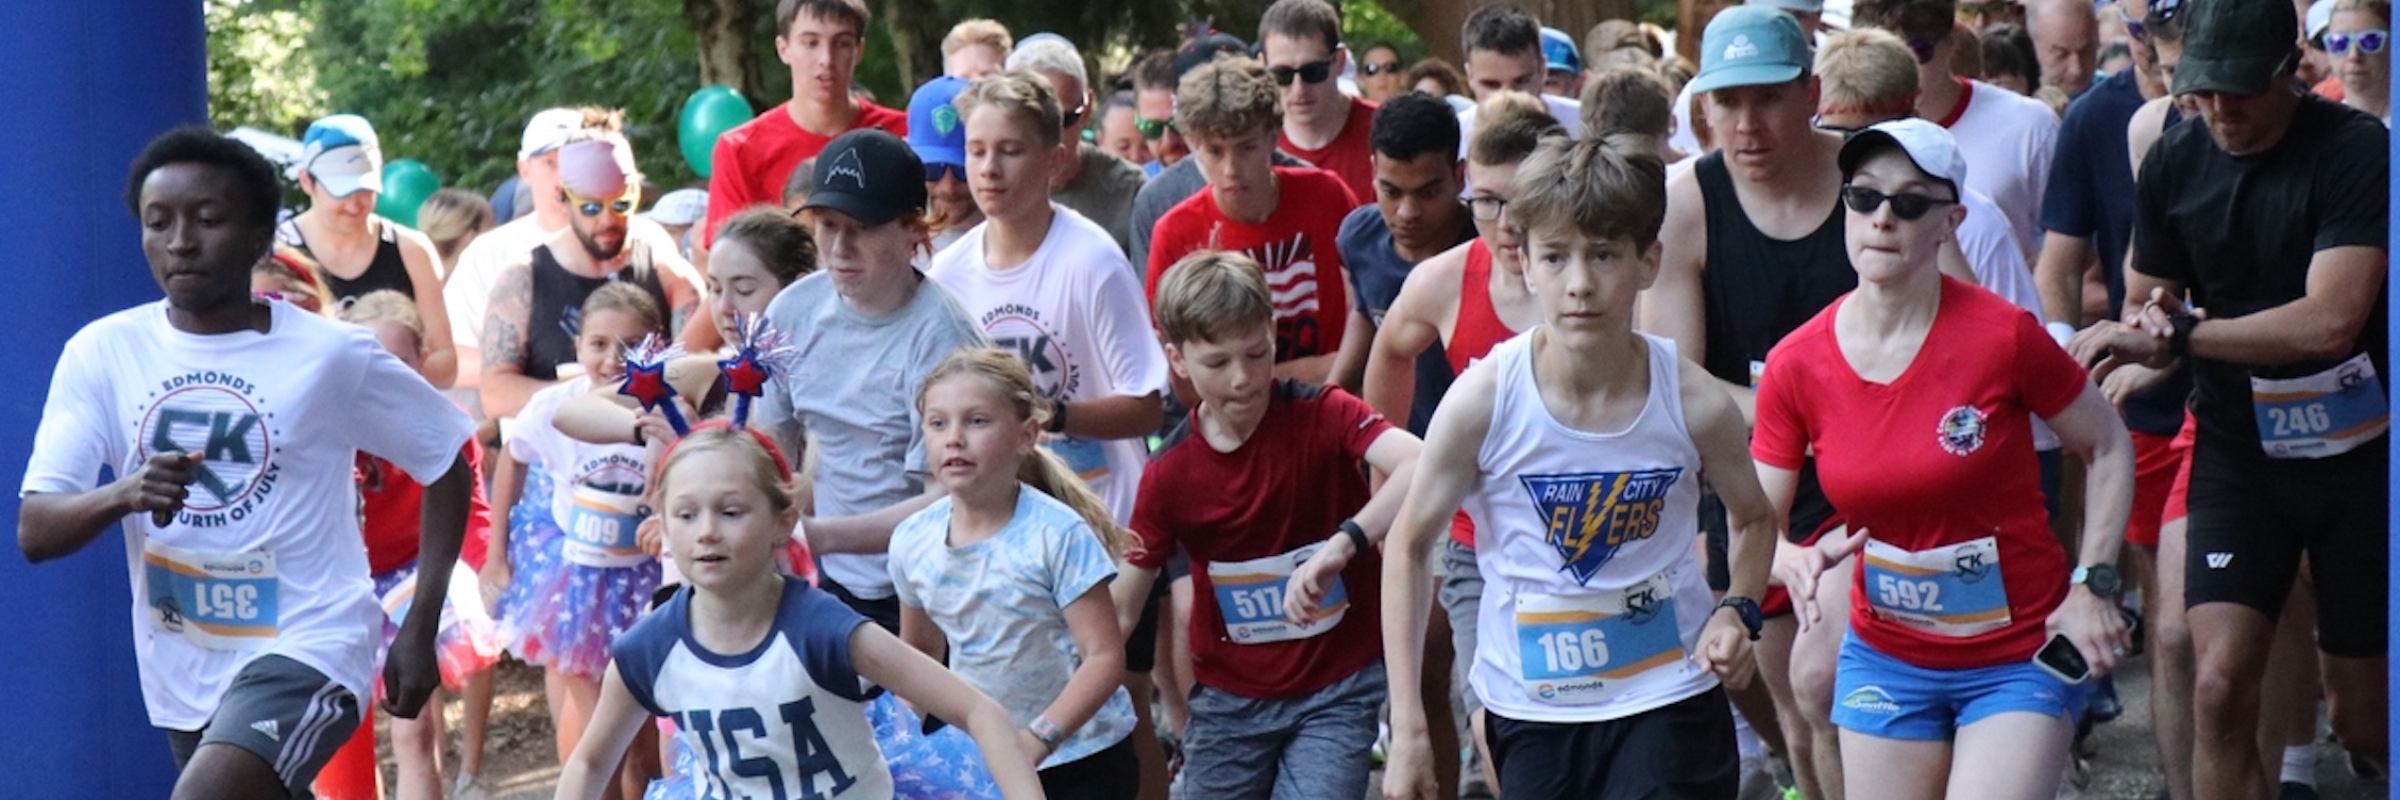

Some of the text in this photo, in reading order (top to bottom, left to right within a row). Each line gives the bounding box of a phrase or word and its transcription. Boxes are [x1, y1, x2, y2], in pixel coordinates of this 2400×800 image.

[981, 304, 1040, 325] EDMONDS
[162, 371, 255, 396] EDMONDS
[1066, 364, 1080, 394] JULY
[2268, 403, 2331, 436] 246
[152, 408, 264, 508] 5K
[583, 454, 645, 473] EDMONDS
[173, 462, 281, 528] URTH OF JULY
[1544, 479, 1662, 502] RAIN CITY
[574, 512, 620, 545] 409
[1545, 480, 1665, 562] FLYERS
[195, 582, 259, 619] 351
[1231, 585, 1283, 619] 517
[1877, 573, 1943, 611] 592
[1538, 628, 1609, 673] 166
[1556, 680, 1604, 694] edmonds
[670, 695, 857, 800] USA
